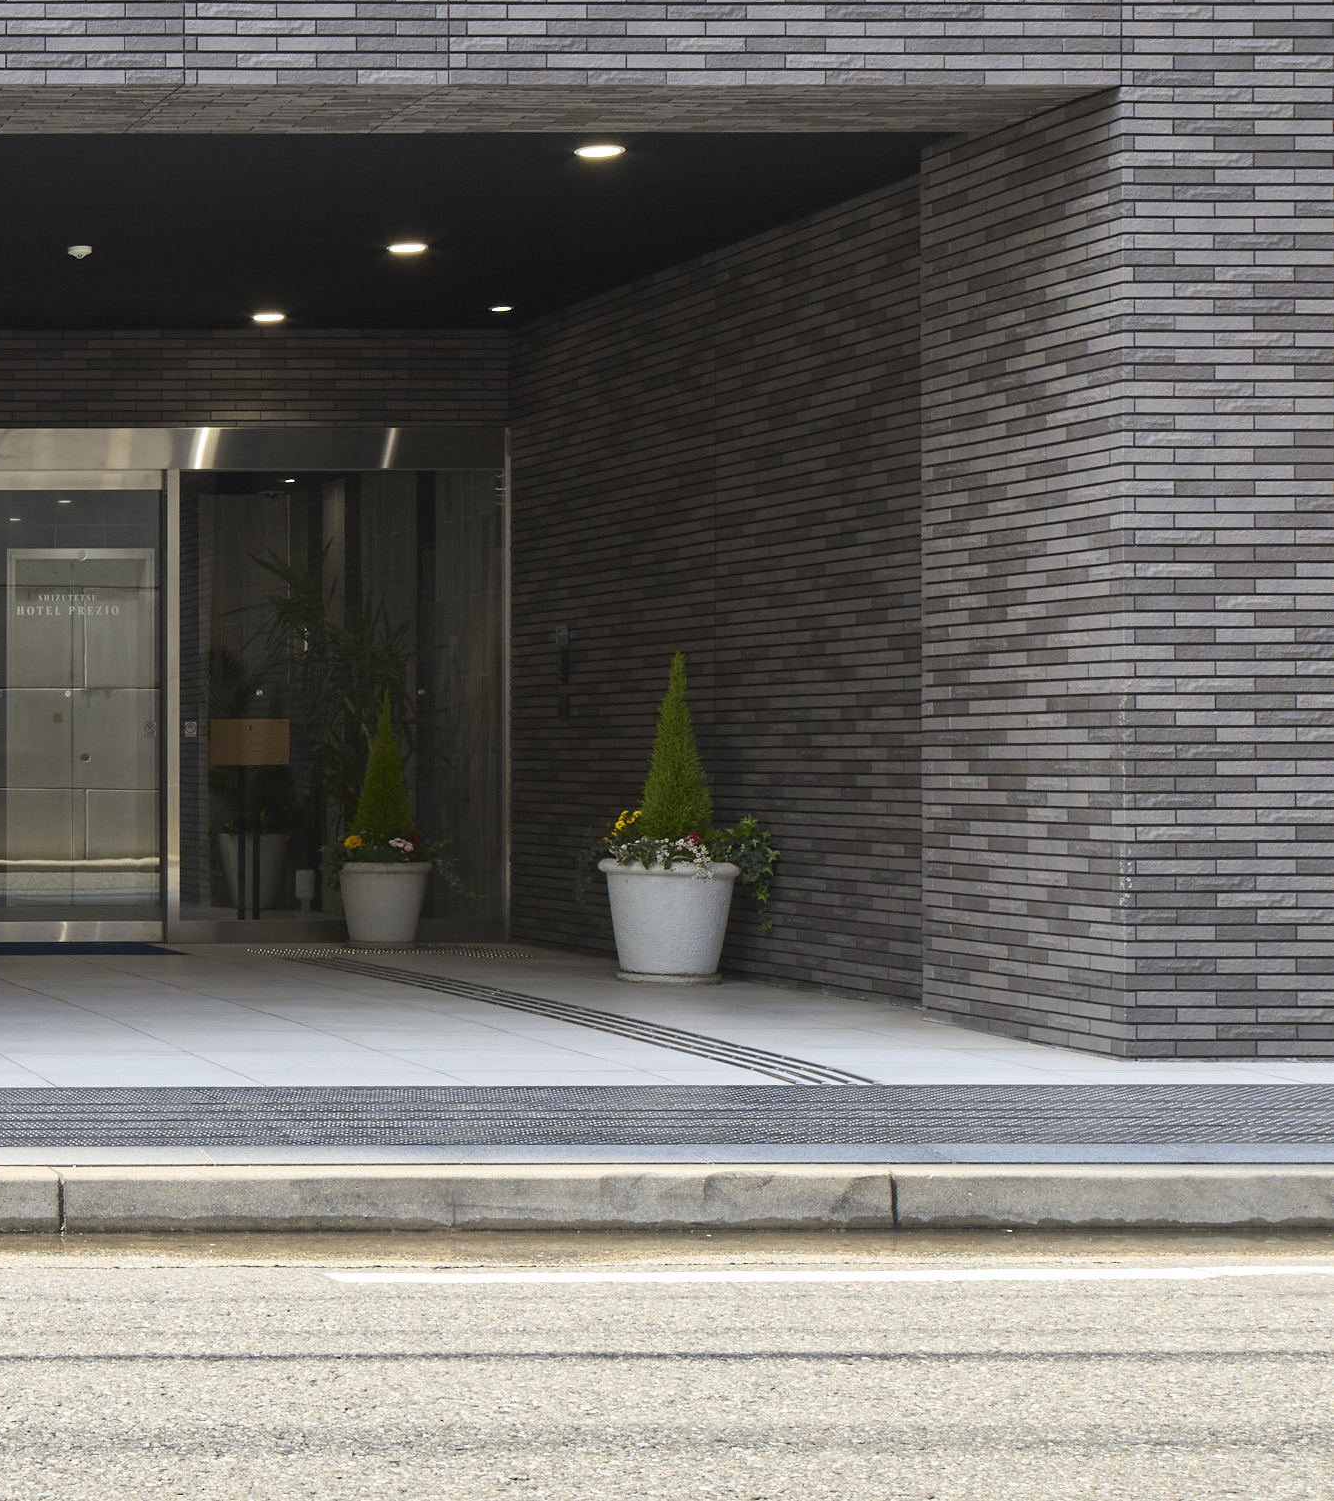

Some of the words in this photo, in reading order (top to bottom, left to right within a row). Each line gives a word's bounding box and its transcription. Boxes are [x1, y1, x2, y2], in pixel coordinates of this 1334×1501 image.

[37, 594, 98, 602] SHIZUTETSU
[16, 605, 61, 616] HOTEL
[68, 605, 120, 616] PREZIO
